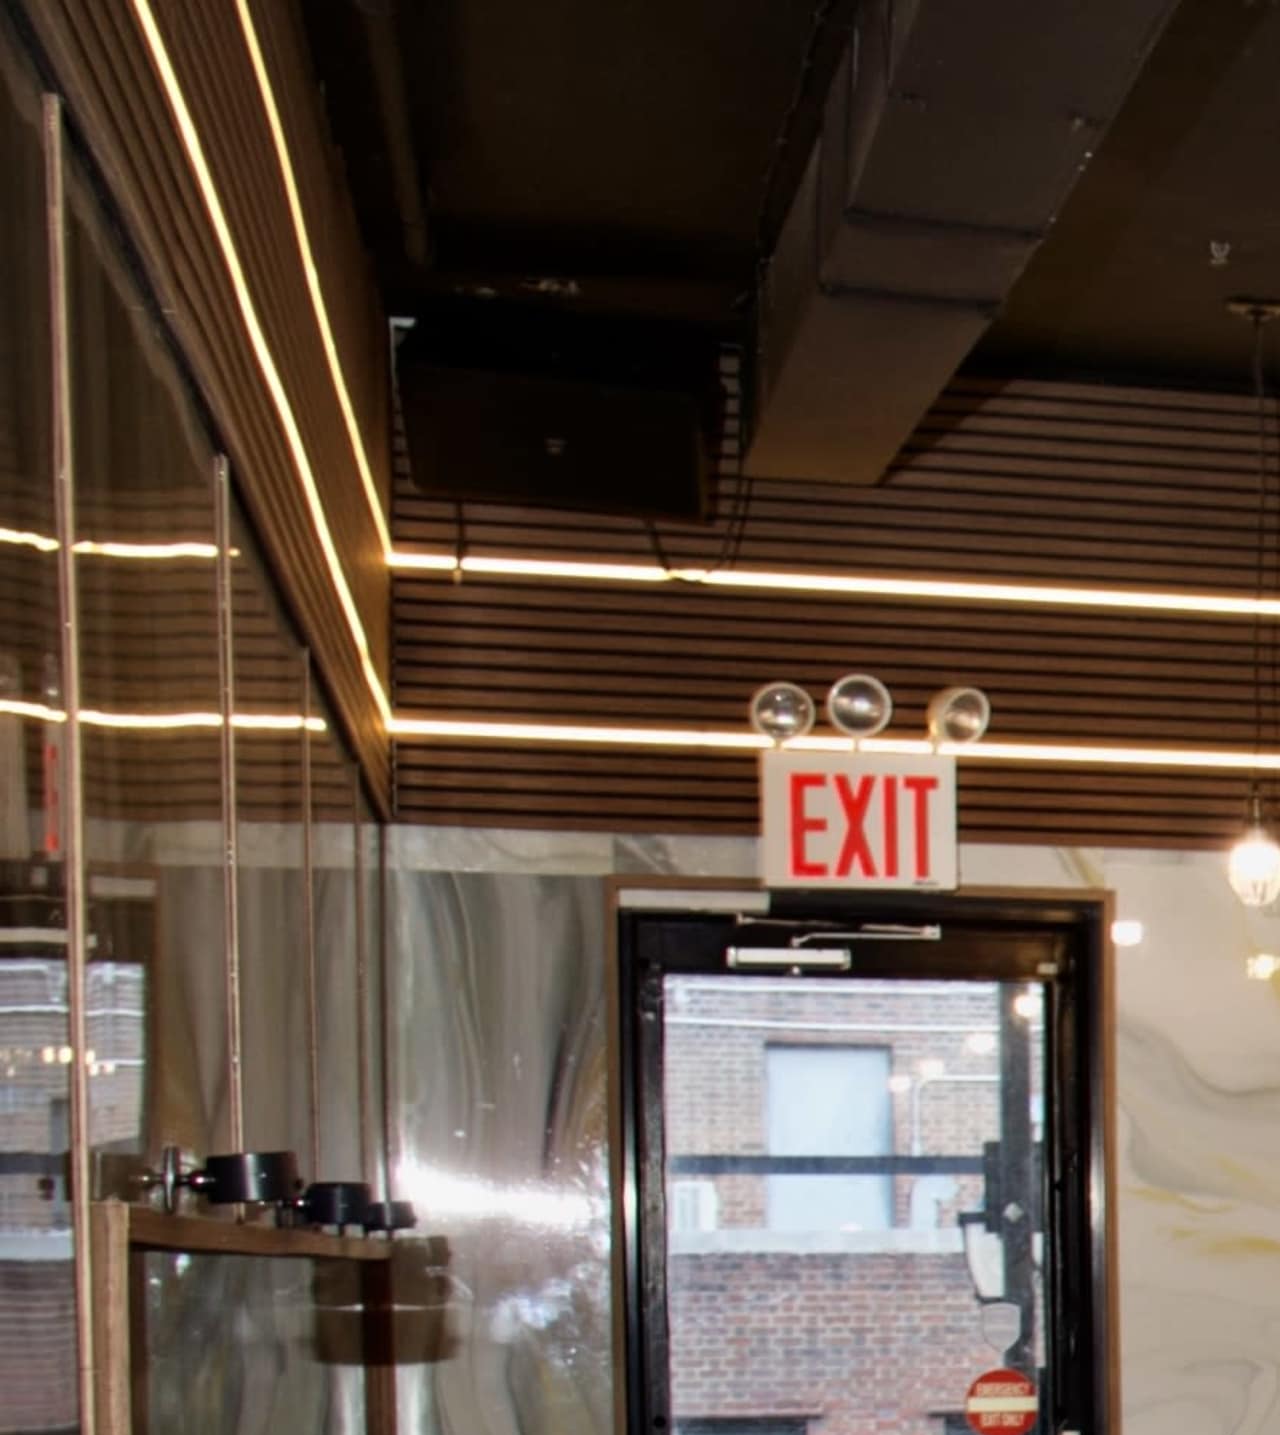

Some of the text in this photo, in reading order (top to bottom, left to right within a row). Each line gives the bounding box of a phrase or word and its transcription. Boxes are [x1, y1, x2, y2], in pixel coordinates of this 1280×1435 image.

[789, 772, 939, 878] EXIT
[976, 1382, 1031, 1397] EMERGENCY
[981, 1412, 1025, 1427] EXIT ONLY
